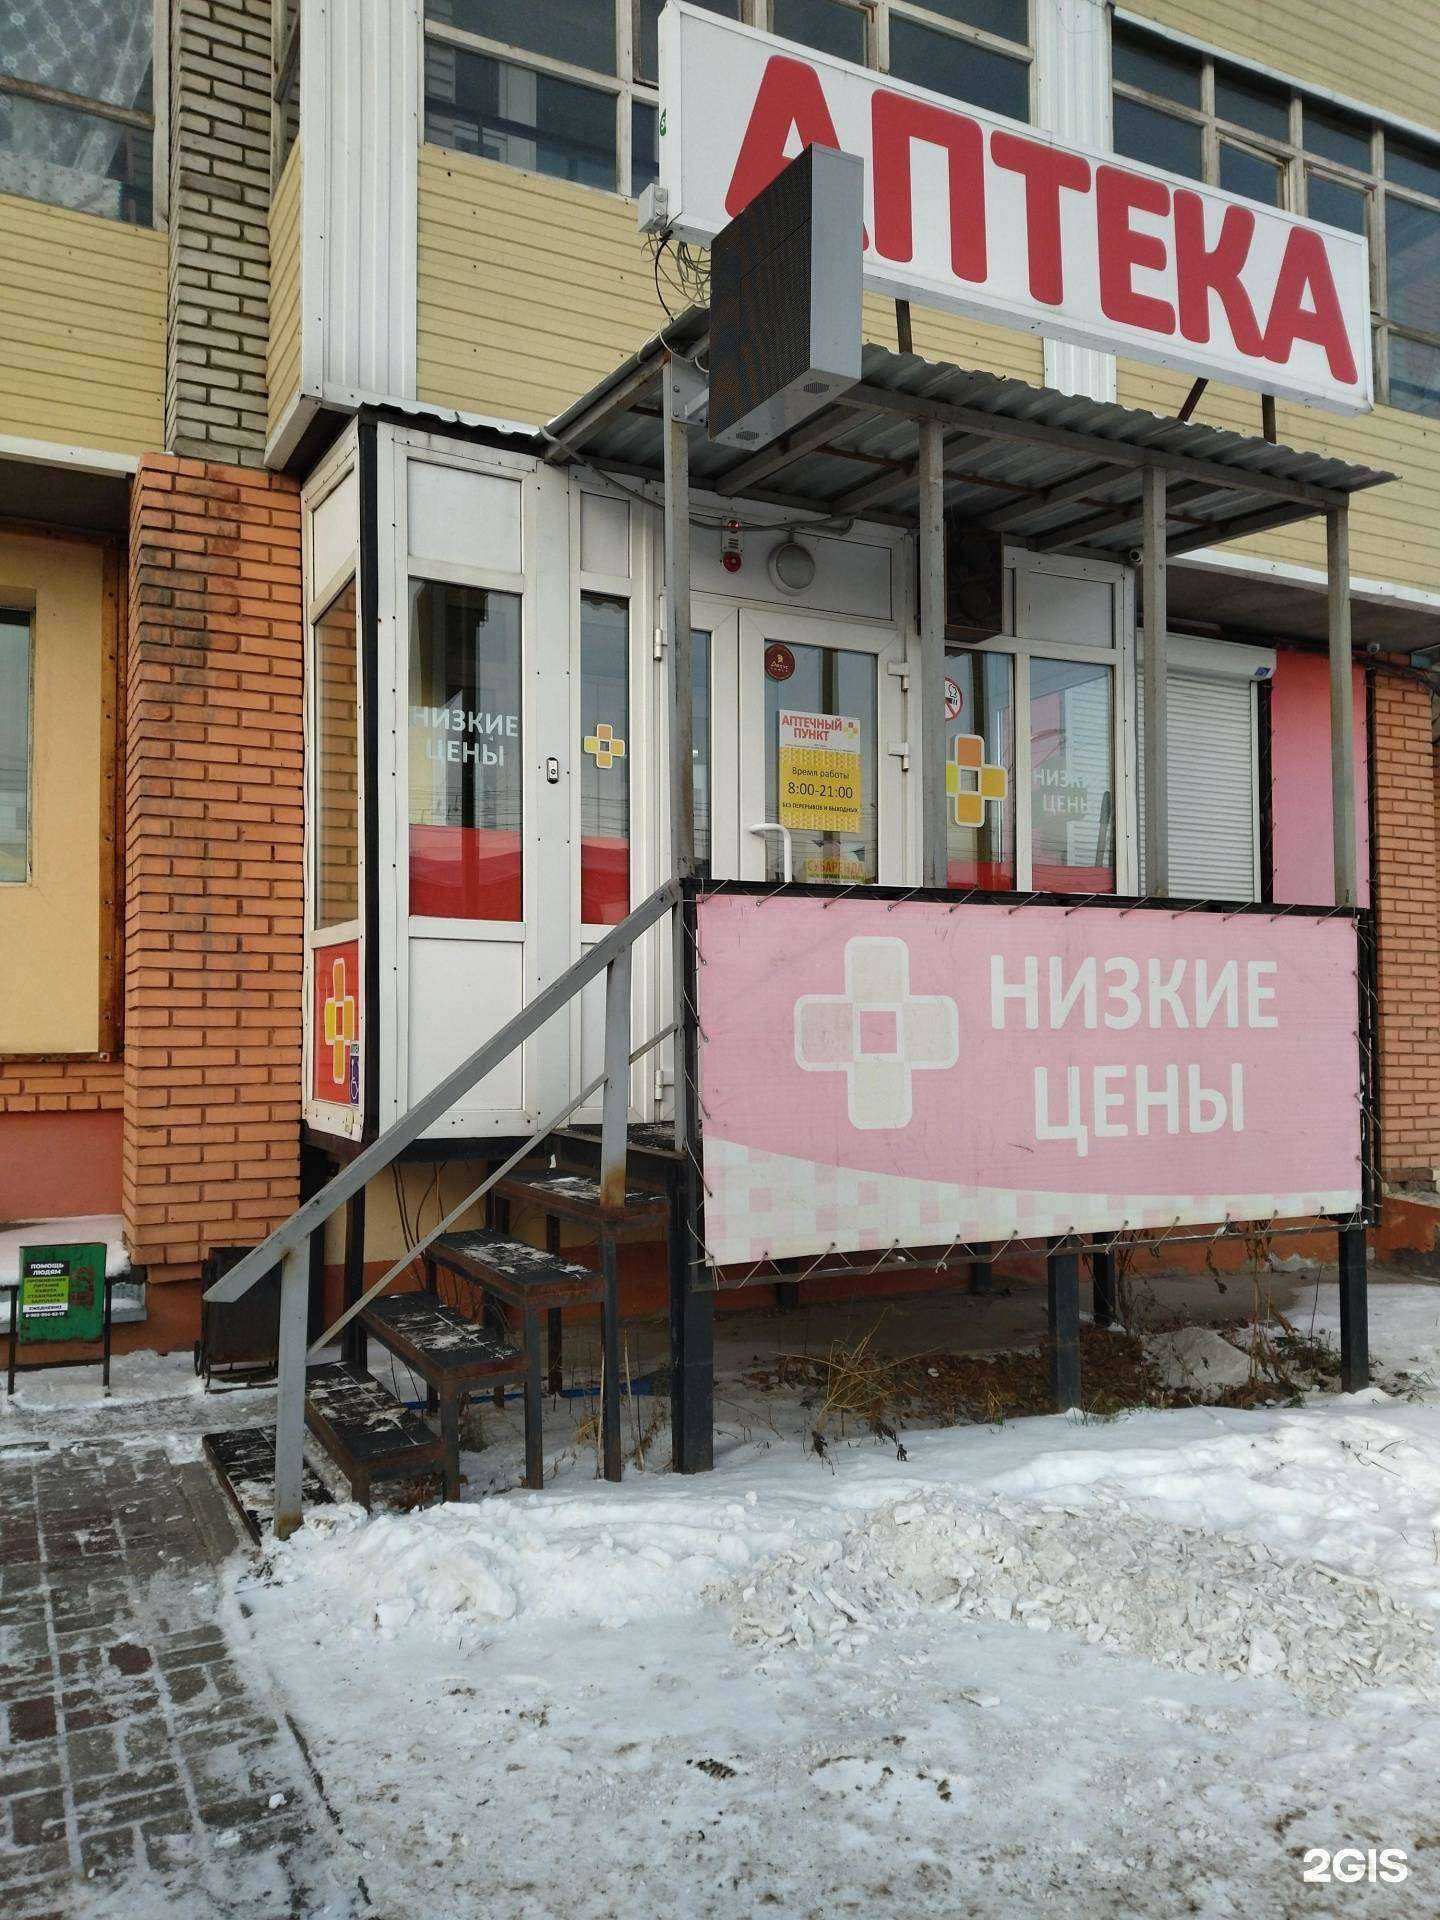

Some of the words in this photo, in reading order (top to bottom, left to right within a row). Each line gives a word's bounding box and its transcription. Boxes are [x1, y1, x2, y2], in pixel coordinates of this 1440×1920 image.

[724, 54, 1359, 385] АПТЕКА
[408, 706, 519, 737] НИЗКИЕ
[782, 715, 843, 731] АПТЕЧНЫЙ
[793, 728, 830, 741] ПУНКТ
[425, 739, 505, 767] ЦЕНЫ
[792, 767, 818, 776] Время
[820, 770, 850, 779] работы
[1034, 768, 1089, 788] НИЗК
[788, 782, 853, 798] 8:00-21:00
[990, 954, 1279, 1030] НИЗКИЕ
[1034, 1062, 1245, 1158] ЦЕНЫ
